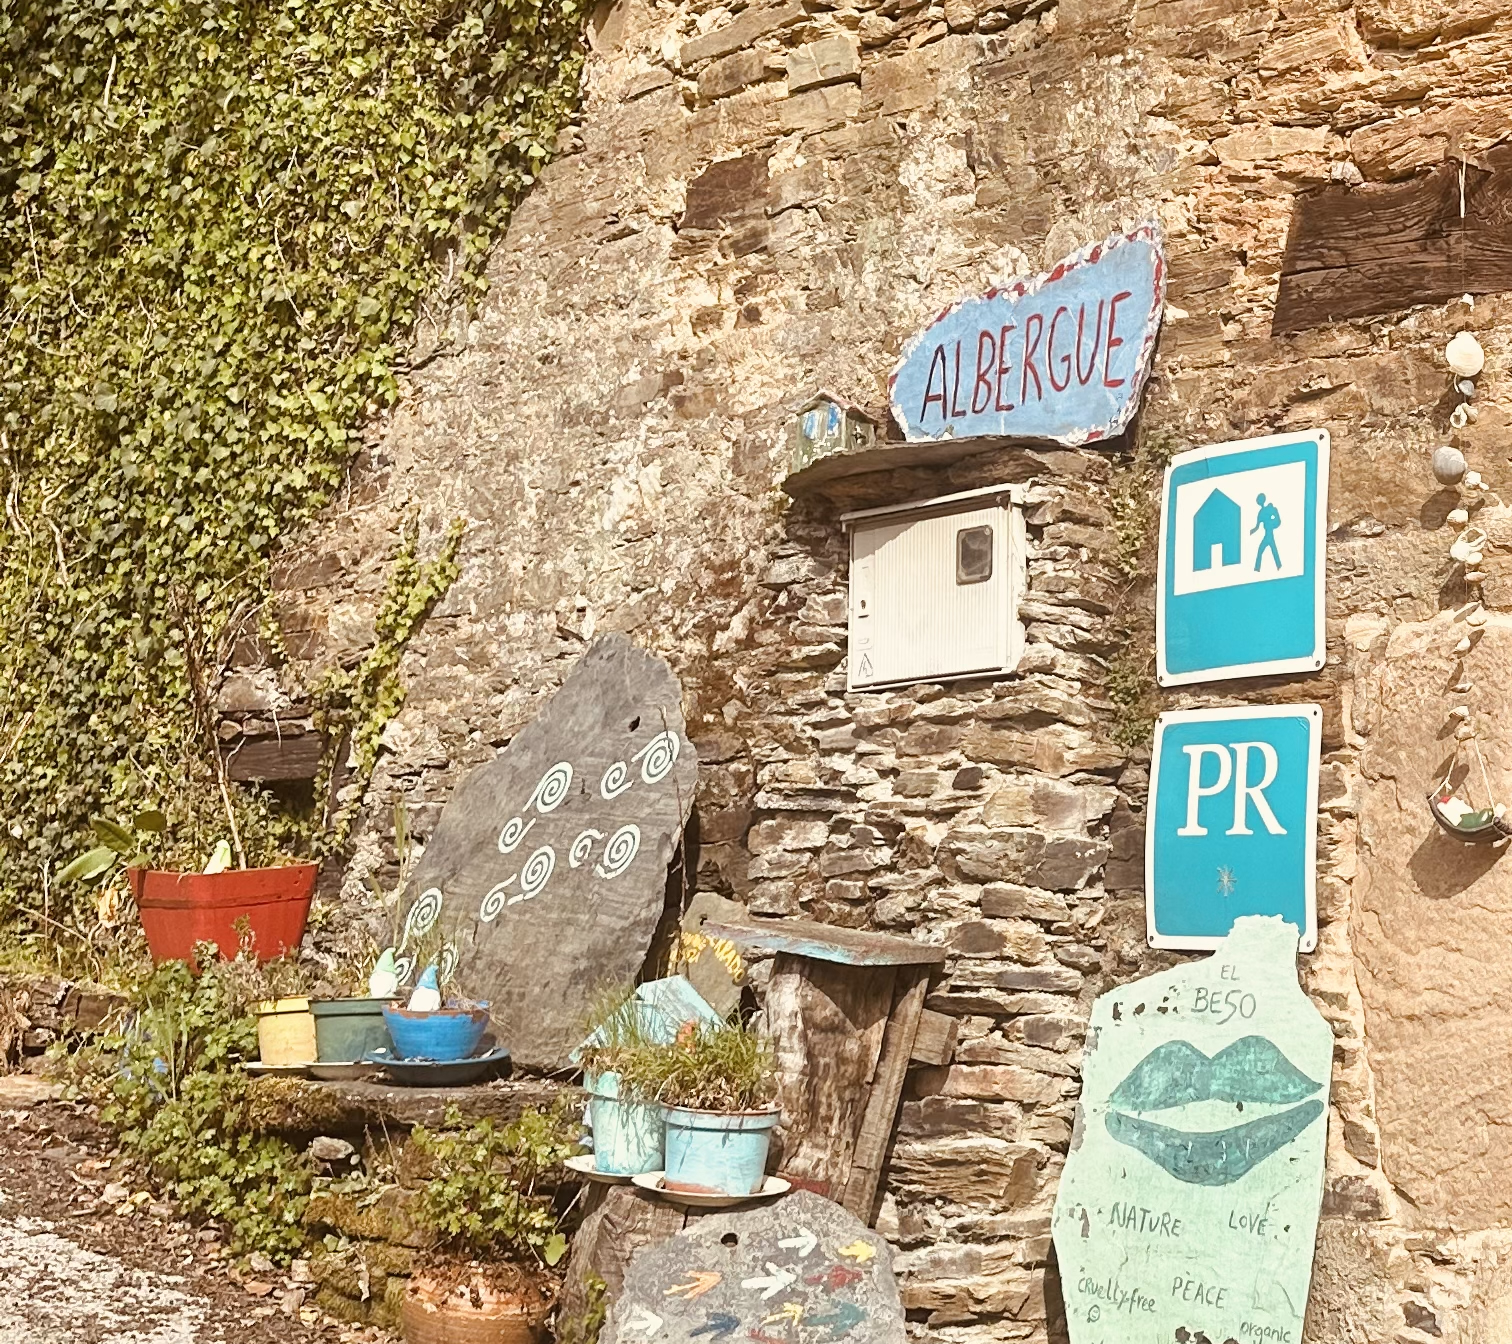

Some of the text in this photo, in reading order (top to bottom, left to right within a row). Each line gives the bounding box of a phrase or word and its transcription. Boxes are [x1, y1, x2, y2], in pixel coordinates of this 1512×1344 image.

[919, 290, 1133, 424] ALBERGUE
[1177, 741, 1288, 837] PR
[1220, 964, 1241, 982] EL
[1190, 986, 1257, 1026] BESO
[1109, 1201, 1182, 1238] NATURE
[1228, 1209, 1269, 1237] LOVE
[1171, 1275, 1228, 1311] PEACE
